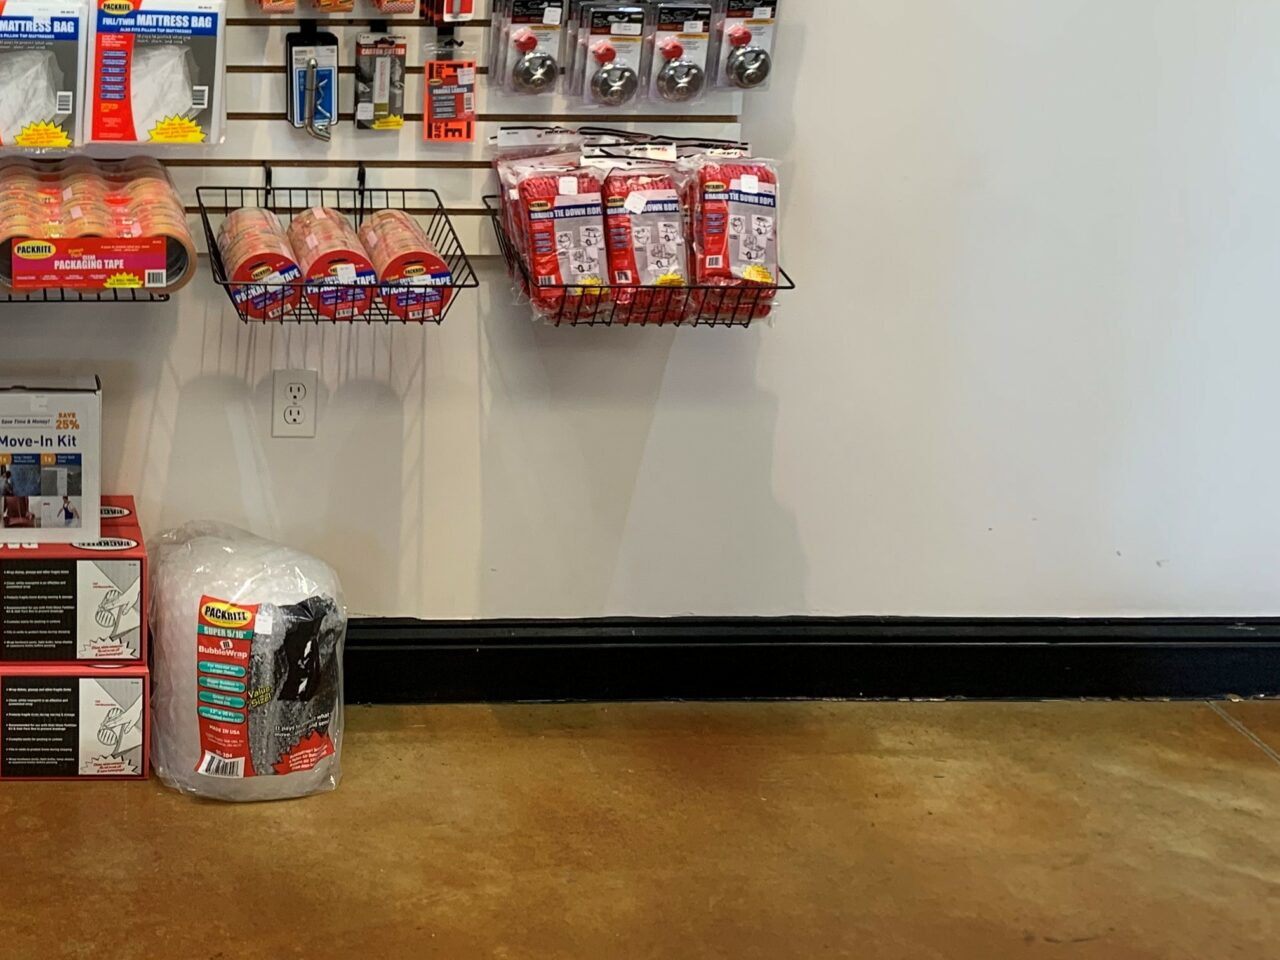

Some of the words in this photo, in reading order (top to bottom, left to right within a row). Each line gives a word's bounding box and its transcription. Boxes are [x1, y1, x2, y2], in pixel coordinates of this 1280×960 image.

[0, 20, 51, 32] MATTRESS
[54, 21, 74, 32] BAG
[103, 17, 135, 25] FULL/TWIN
[137, 14, 189, 27] MATTRESS
[191, 15, 212, 28] BAG
[740, 194, 758, 202] DOWN
[759, 196, 774, 205] ROPE
[17, 245, 51, 254] PACKRITE
[54, 260, 102, 270] PACKAGING
[104, 259, 124, 269] TAPE
[56, 420, 79, 430] 25%
[58, 435, 77, 447] Kit
[204, 626, 225, 637] SUPER
[199, 645, 247, 659] BubbleWrap
